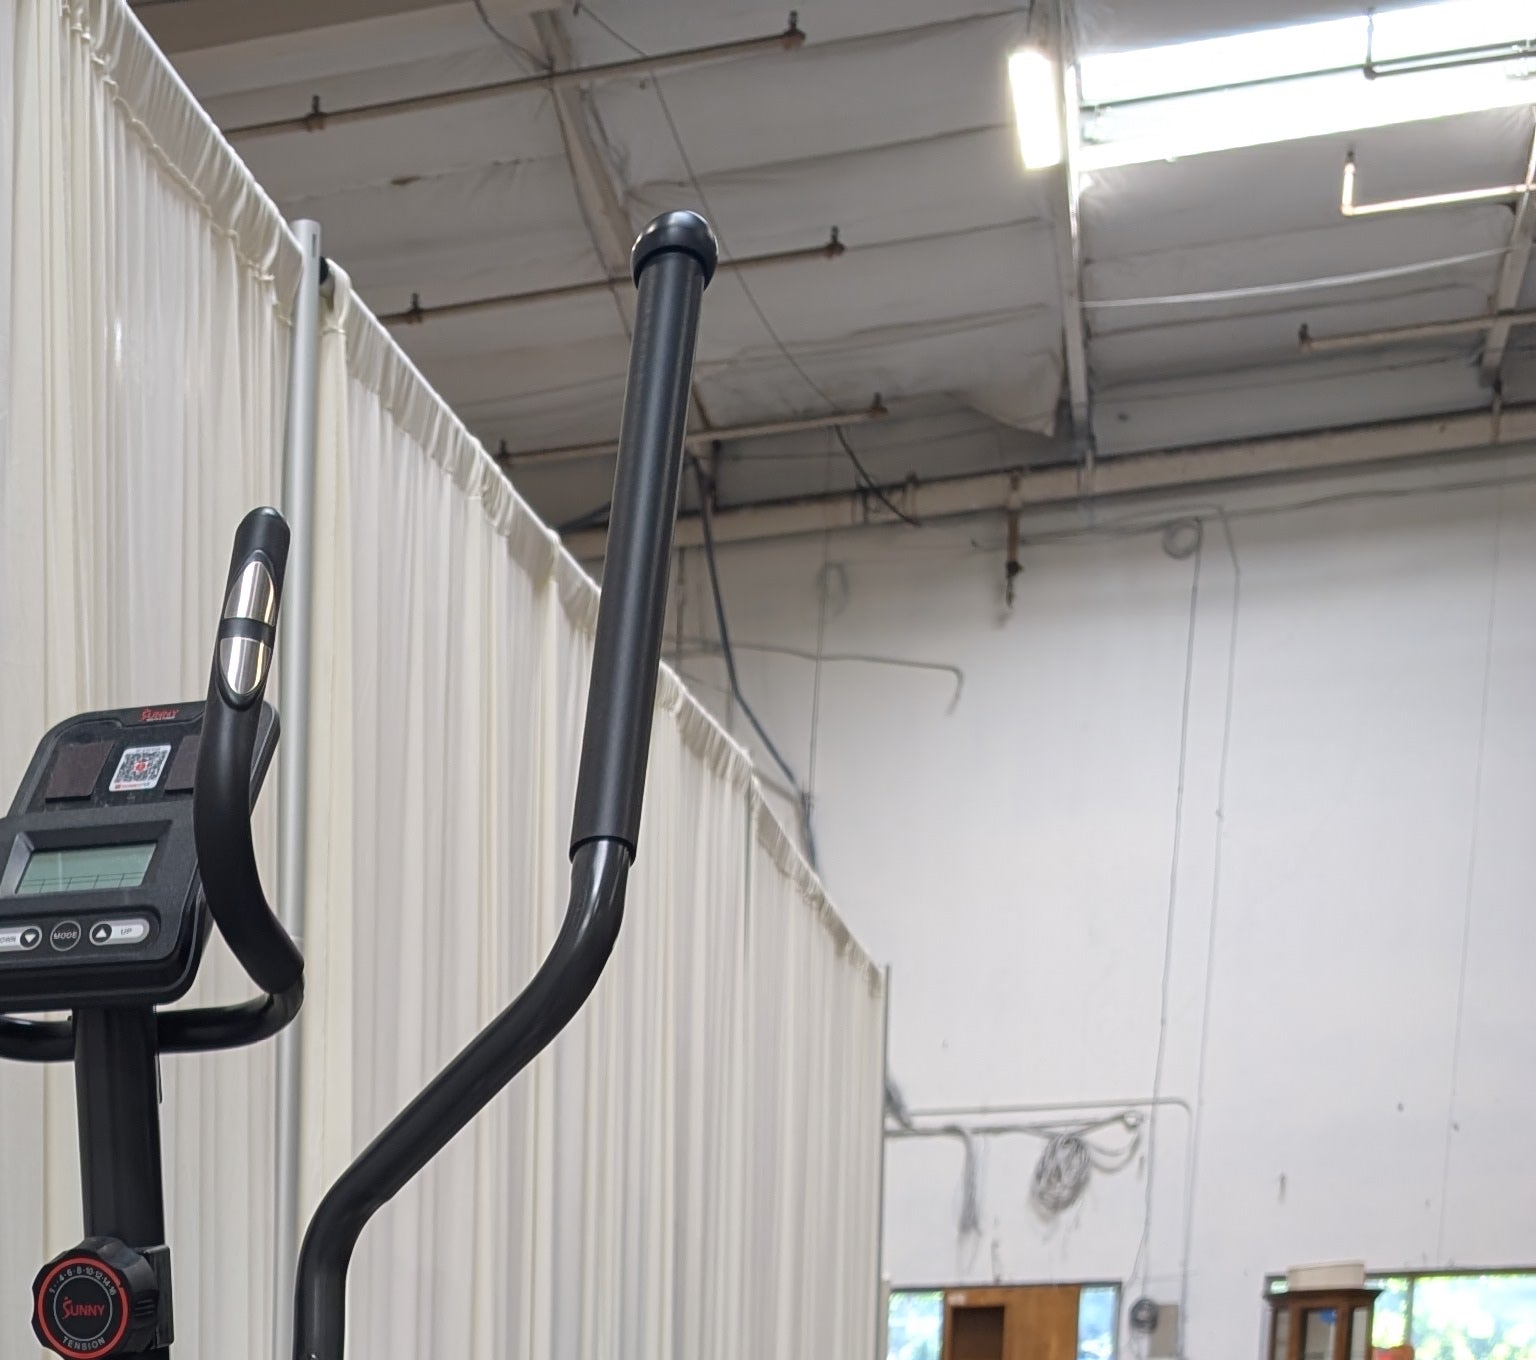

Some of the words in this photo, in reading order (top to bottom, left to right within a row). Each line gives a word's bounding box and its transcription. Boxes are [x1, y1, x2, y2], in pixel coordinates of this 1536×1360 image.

[53, 931, 77, 940] MODE
[62, 1297, 106, 1320] SUNNY
[63, 1336, 106, 1351] TENSION
